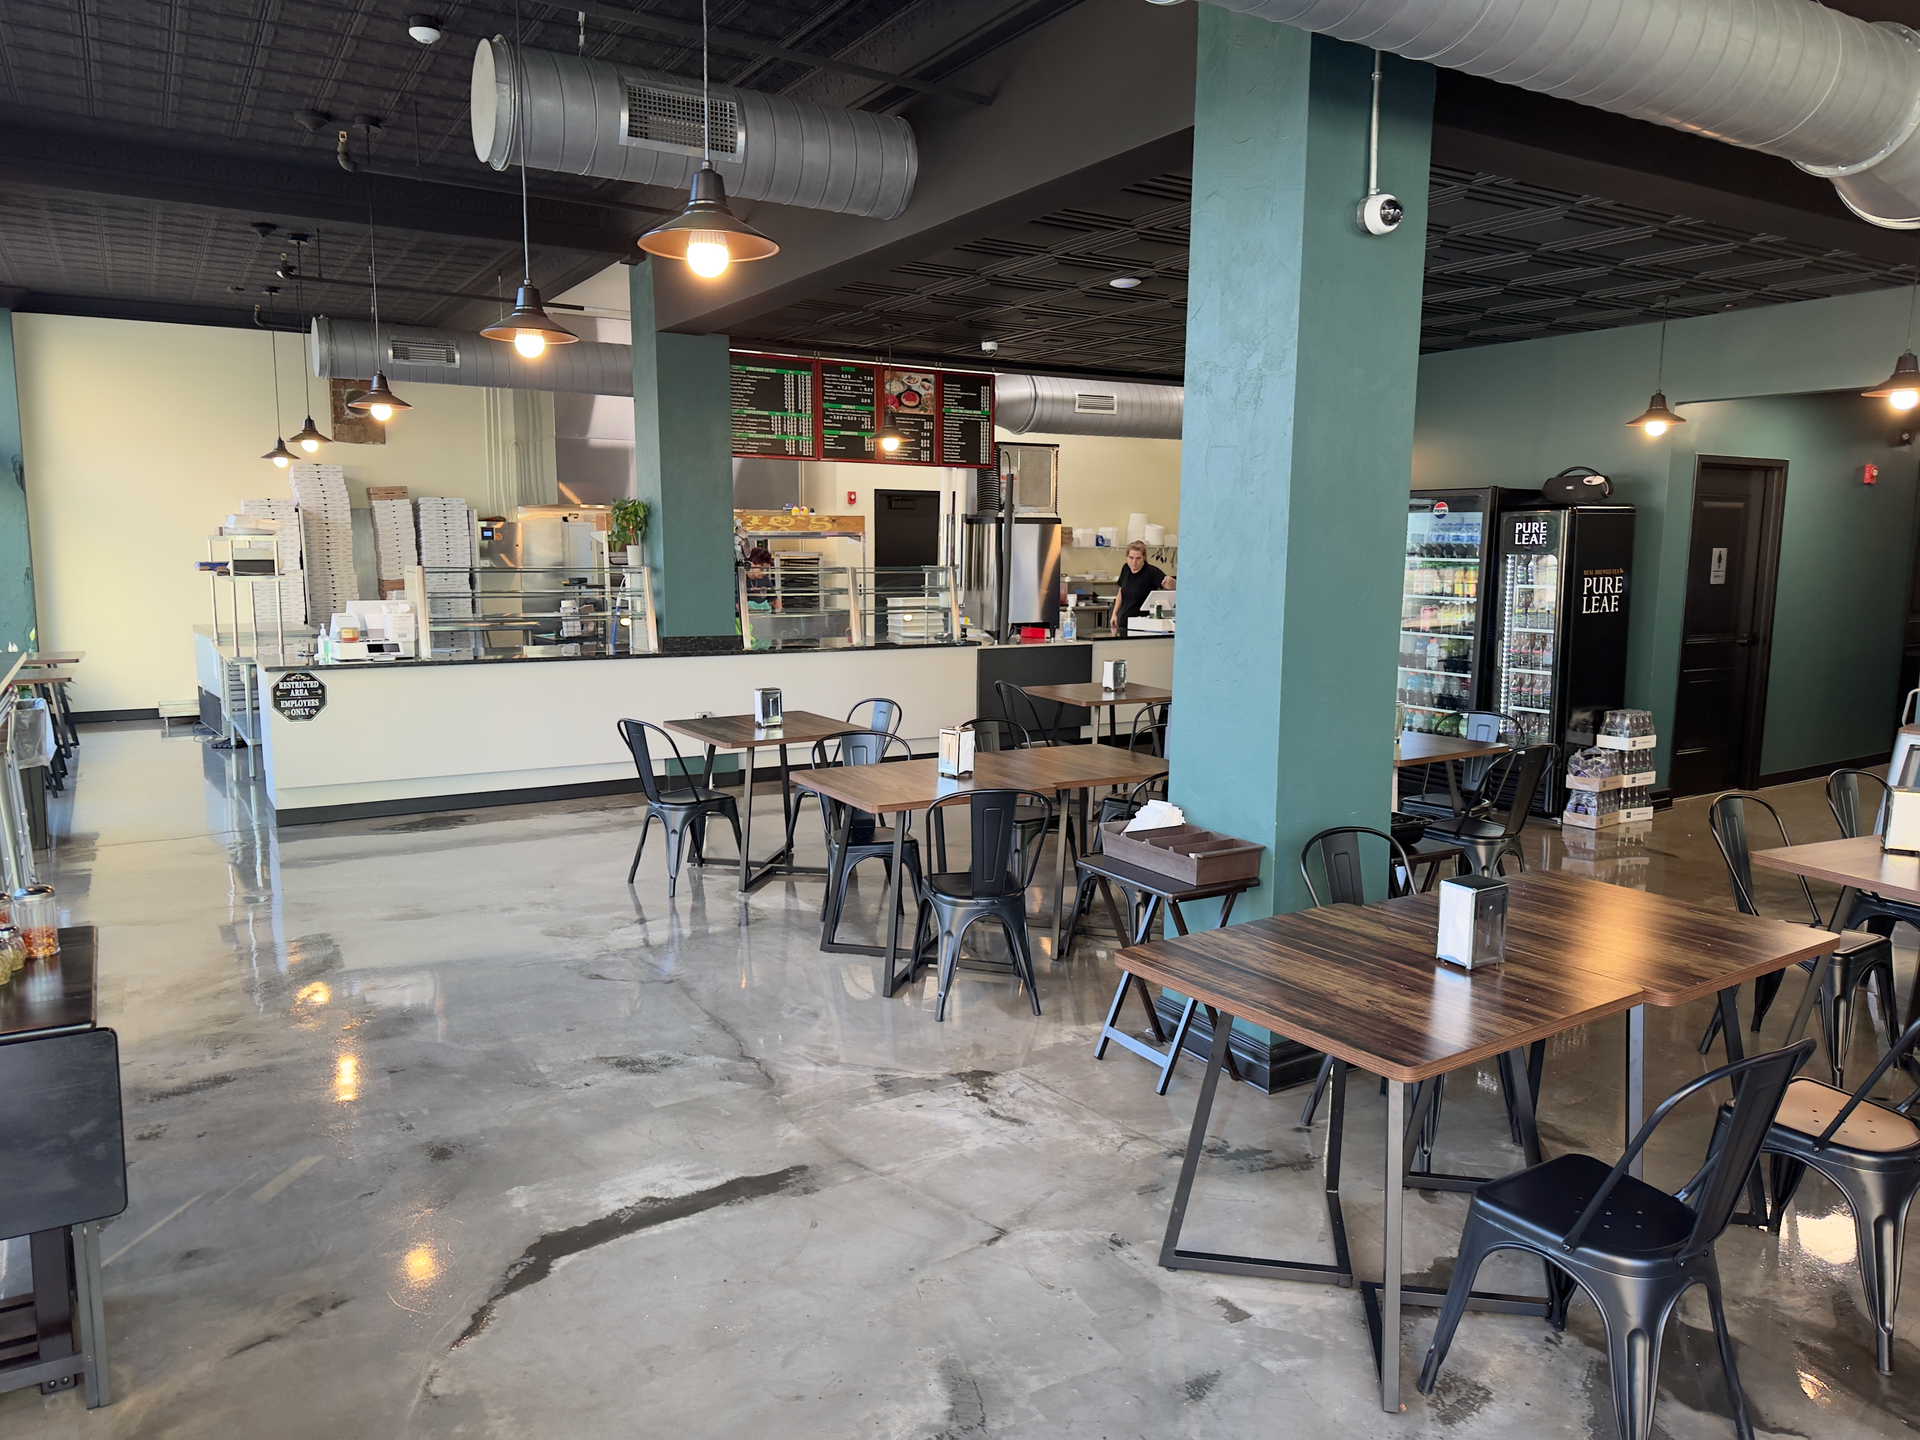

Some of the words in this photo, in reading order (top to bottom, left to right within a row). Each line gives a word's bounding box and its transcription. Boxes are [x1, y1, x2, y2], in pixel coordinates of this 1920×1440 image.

[1514, 521, 1548, 534] PURE
[1582, 576, 1624, 595] PURE
[279, 681, 319, 689] RESTRICTED
[280, 699, 319, 707] EMPLOYEES
[290, 708, 310, 716] ONLY
